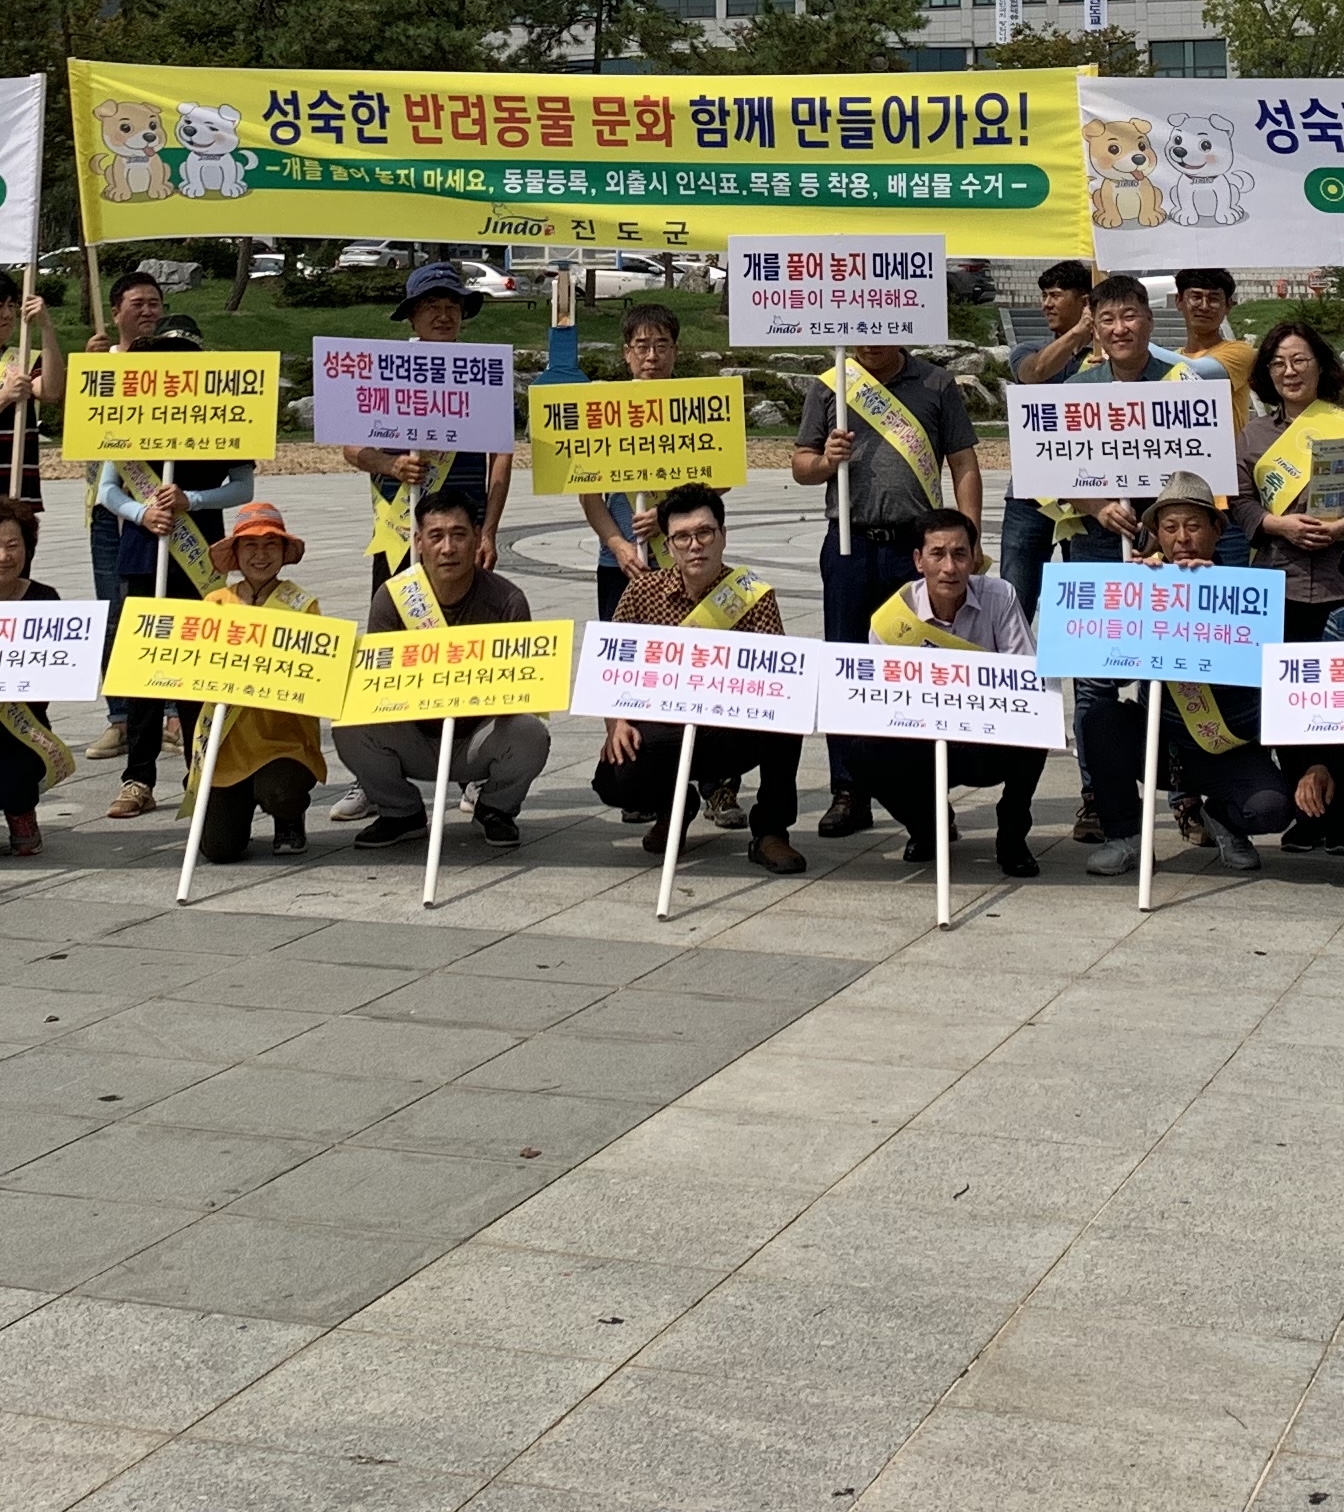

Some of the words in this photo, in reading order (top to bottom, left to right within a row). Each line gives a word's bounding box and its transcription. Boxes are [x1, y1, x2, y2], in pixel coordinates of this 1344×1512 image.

[262, 90, 390, 146] 성숙한
[404, 94, 574, 148] 반려동물
[592, 95, 676, 148] 문화
[689, 94, 775, 148] 함께
[791, 92, 1028, 150] 만들어가요!
[375, 167, 415, 189] 놓지
[503, 168, 596, 196] 동물등록,
[606, 170, 668, 195] 외출시
[799, 173, 820, 198] 등
[828, 173, 878, 200] 착용,
[888, 173, 952, 198] 배설물
[960, 173, 1003, 198] 수거
[478, 218, 542, 236] Jindo
[743, 253, 781, 281] 개를
[787, 252, 823, 281] 풀어
[830, 252, 866, 281] 놓지
[873, 252, 933, 280] 마세요!
[752, 289, 823, 309] 아이들이
[830, 289, 925, 309] 무서워해요.
[767, 325, 796, 335] Jindo
[888, 321, 913, 334] 단체
[323, 351, 373, 380] 성숙한
[378, 354, 446, 384] 반려동물
[452, 357, 505, 386] 문화를
[80, 370, 116, 397] 개를
[122, 370, 157, 397] 풀어
[163, 370, 199, 398] 놓지
[205, 369, 264, 396] 마세요!
[88, 405, 144, 424] 거리가
[151, 405, 253, 424] 더러워져요.
[356, 387, 389, 416] 함께
[395, 389, 470, 419] 만듭시다!
[544, 403, 580, 431] 개를
[586, 400, 621, 429] 풀어
[628, 398, 664, 428] 놓지
[670, 395, 730, 425] 마세요!
[1022, 403, 1059, 432] 개를
[1064, 402, 1102, 431] 풀어
[1108, 401, 1147, 431] 놓지
[1152, 398, 1218, 429] 마세요!
[555, 437, 611, 458] 거리가
[619, 433, 723, 455] 더러워져요.
[1035, 440, 1093, 461] 거리가
[1102, 438, 1211, 460] 더러워져요.
[687, 466, 712, 479] 단체
[1056, 581, 1096, 610] 개를
[1103, 581, 1143, 611] 풀어
[1151, 583, 1191, 612] 놓지
[1198, 584, 1268, 616] 마세요!
[23, 617, 91, 642] 마세요!
[133, 614, 174, 639] 개를
[180, 616, 221, 642] 풀어
[226, 620, 268, 648] 놓지
[272, 626, 339, 658] 마세요!
[1066, 618, 1142, 639] 아이들이
[1152, 621, 1259, 646] 무서워해요.
[138, 646, 201, 666] 거리가
[210, 651, 321, 683] 더러워져요.
[355, 647, 394, 670] 개를
[401, 642, 440, 668] 풀어
[446, 639, 485, 664] 놓지
[491, 635, 558, 661] 마세요!
[597, 637, 638, 663] 개를
[644, 640, 684, 666] 풀어
[690, 643, 731, 669] 놓지
[737, 648, 805, 676] 마세요!
[362, 673, 424, 693] 거리가
[432, 666, 544, 686] 더러워져요.
[602, 668, 679, 689] 아이들이
[687, 674, 791, 700] 무서워해요.
[835, 656, 876, 681] 개를
[883, 659, 922, 684] 풀어
[930, 662, 970, 687] 놓지
[1279, 658, 1321, 684] 개를
[848, 687, 912, 705] 거리가
[922, 691, 1039, 715] 더러워져요.
